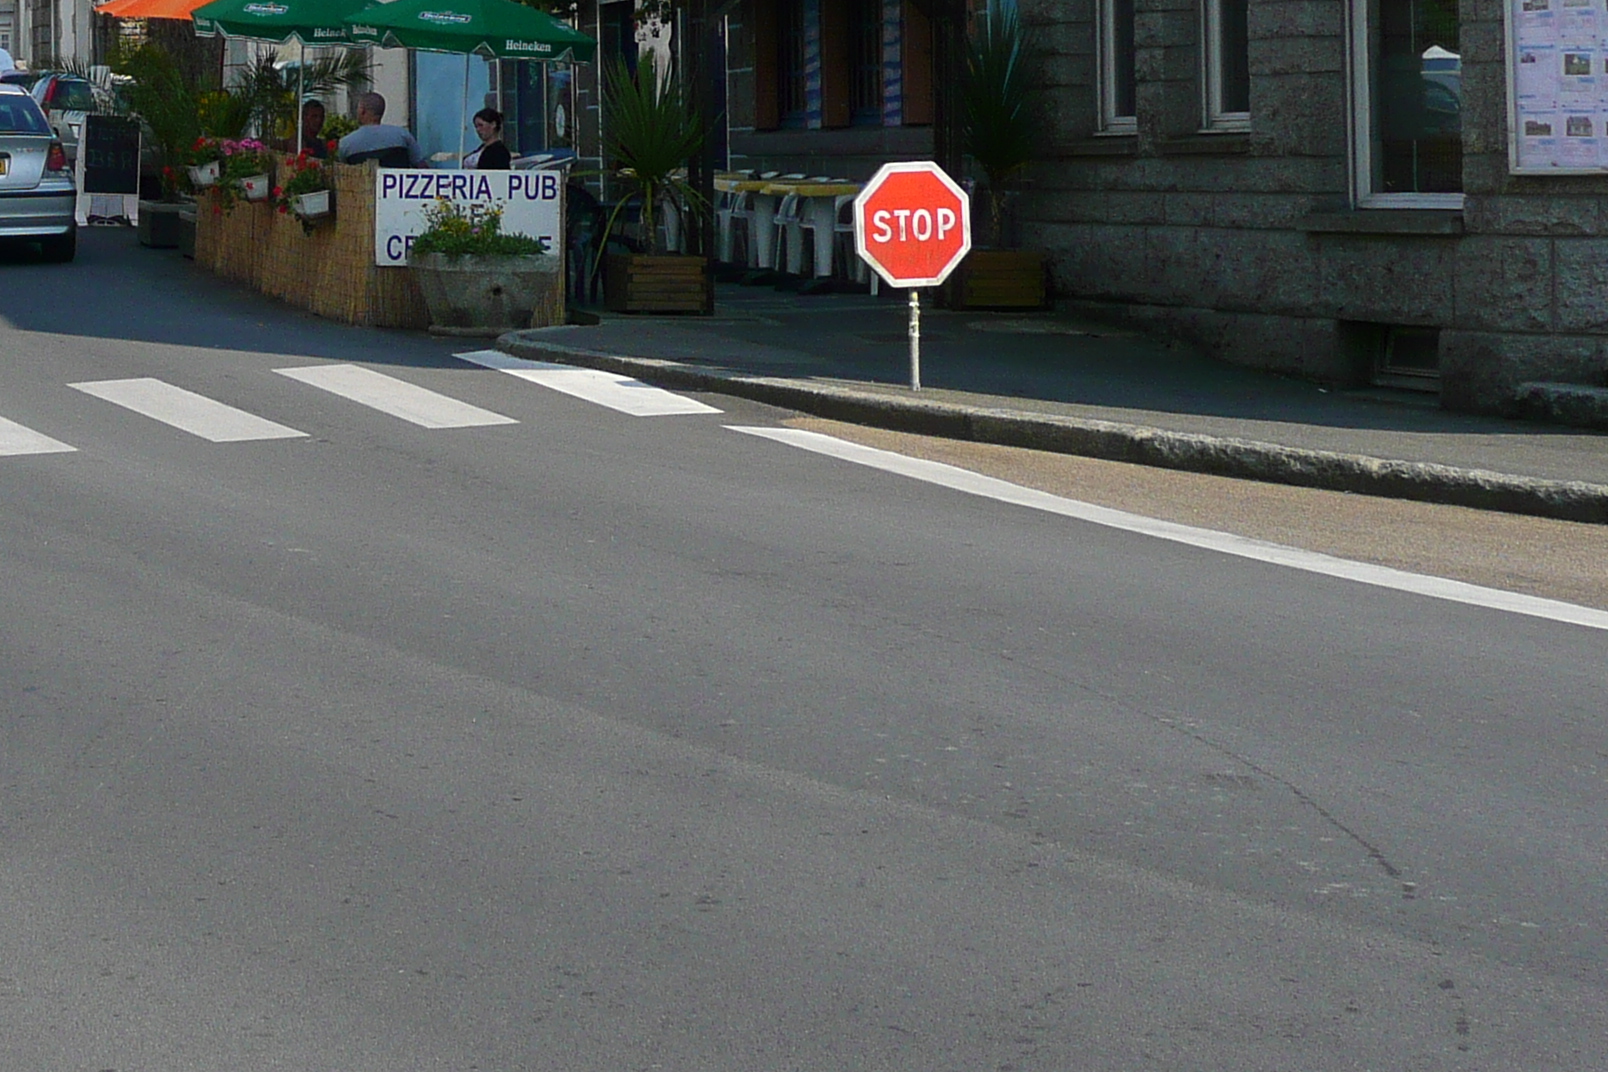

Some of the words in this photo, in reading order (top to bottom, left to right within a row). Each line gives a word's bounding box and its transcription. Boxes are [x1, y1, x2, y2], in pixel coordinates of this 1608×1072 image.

[506, 39, 552, 52] Heineken
[383, 174, 492, 199] PIZZERIA
[508, 174, 557, 200] PUB
[872, 208, 956, 243] STOP
